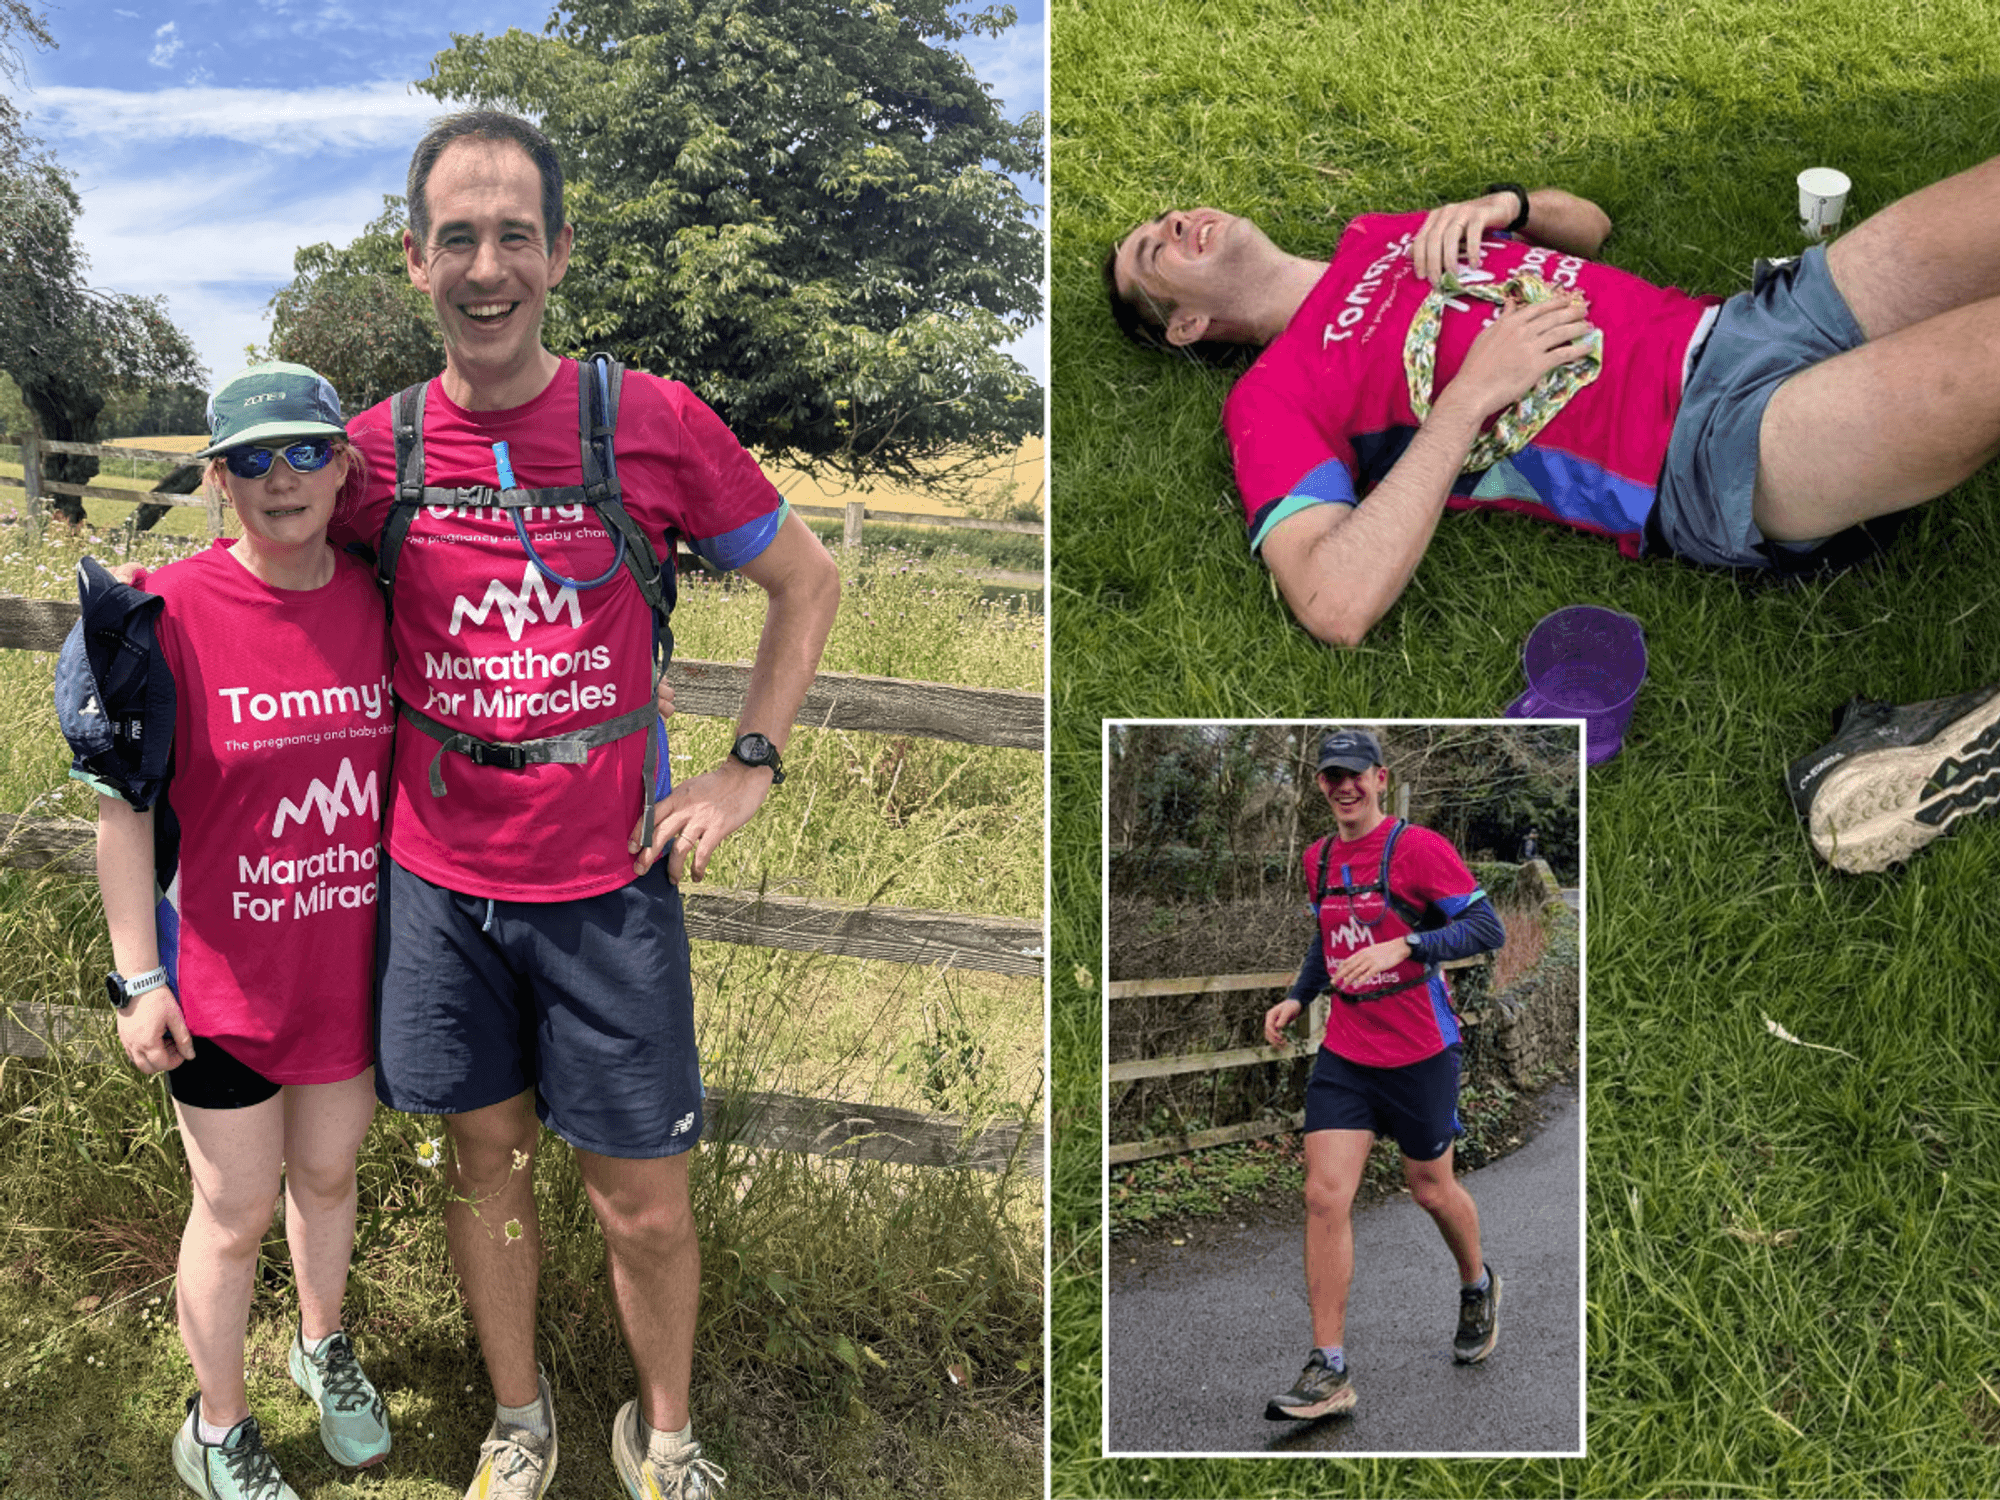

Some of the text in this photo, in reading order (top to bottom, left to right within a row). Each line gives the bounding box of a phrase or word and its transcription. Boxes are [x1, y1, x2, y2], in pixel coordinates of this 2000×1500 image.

[428, 533, 499, 546] pregnancy
[502, 534, 526, 543] an
[534, 529, 573, 542] baby
[425, 645, 612, 681] Marathons
[473, 680, 618, 719] Miracles
[223, 738, 251, 752] The
[252, 733, 322, 751] pregnancy
[323, 726, 347, 741] and
[348, 725, 377, 739] baby
[232, 891, 286, 922] For
